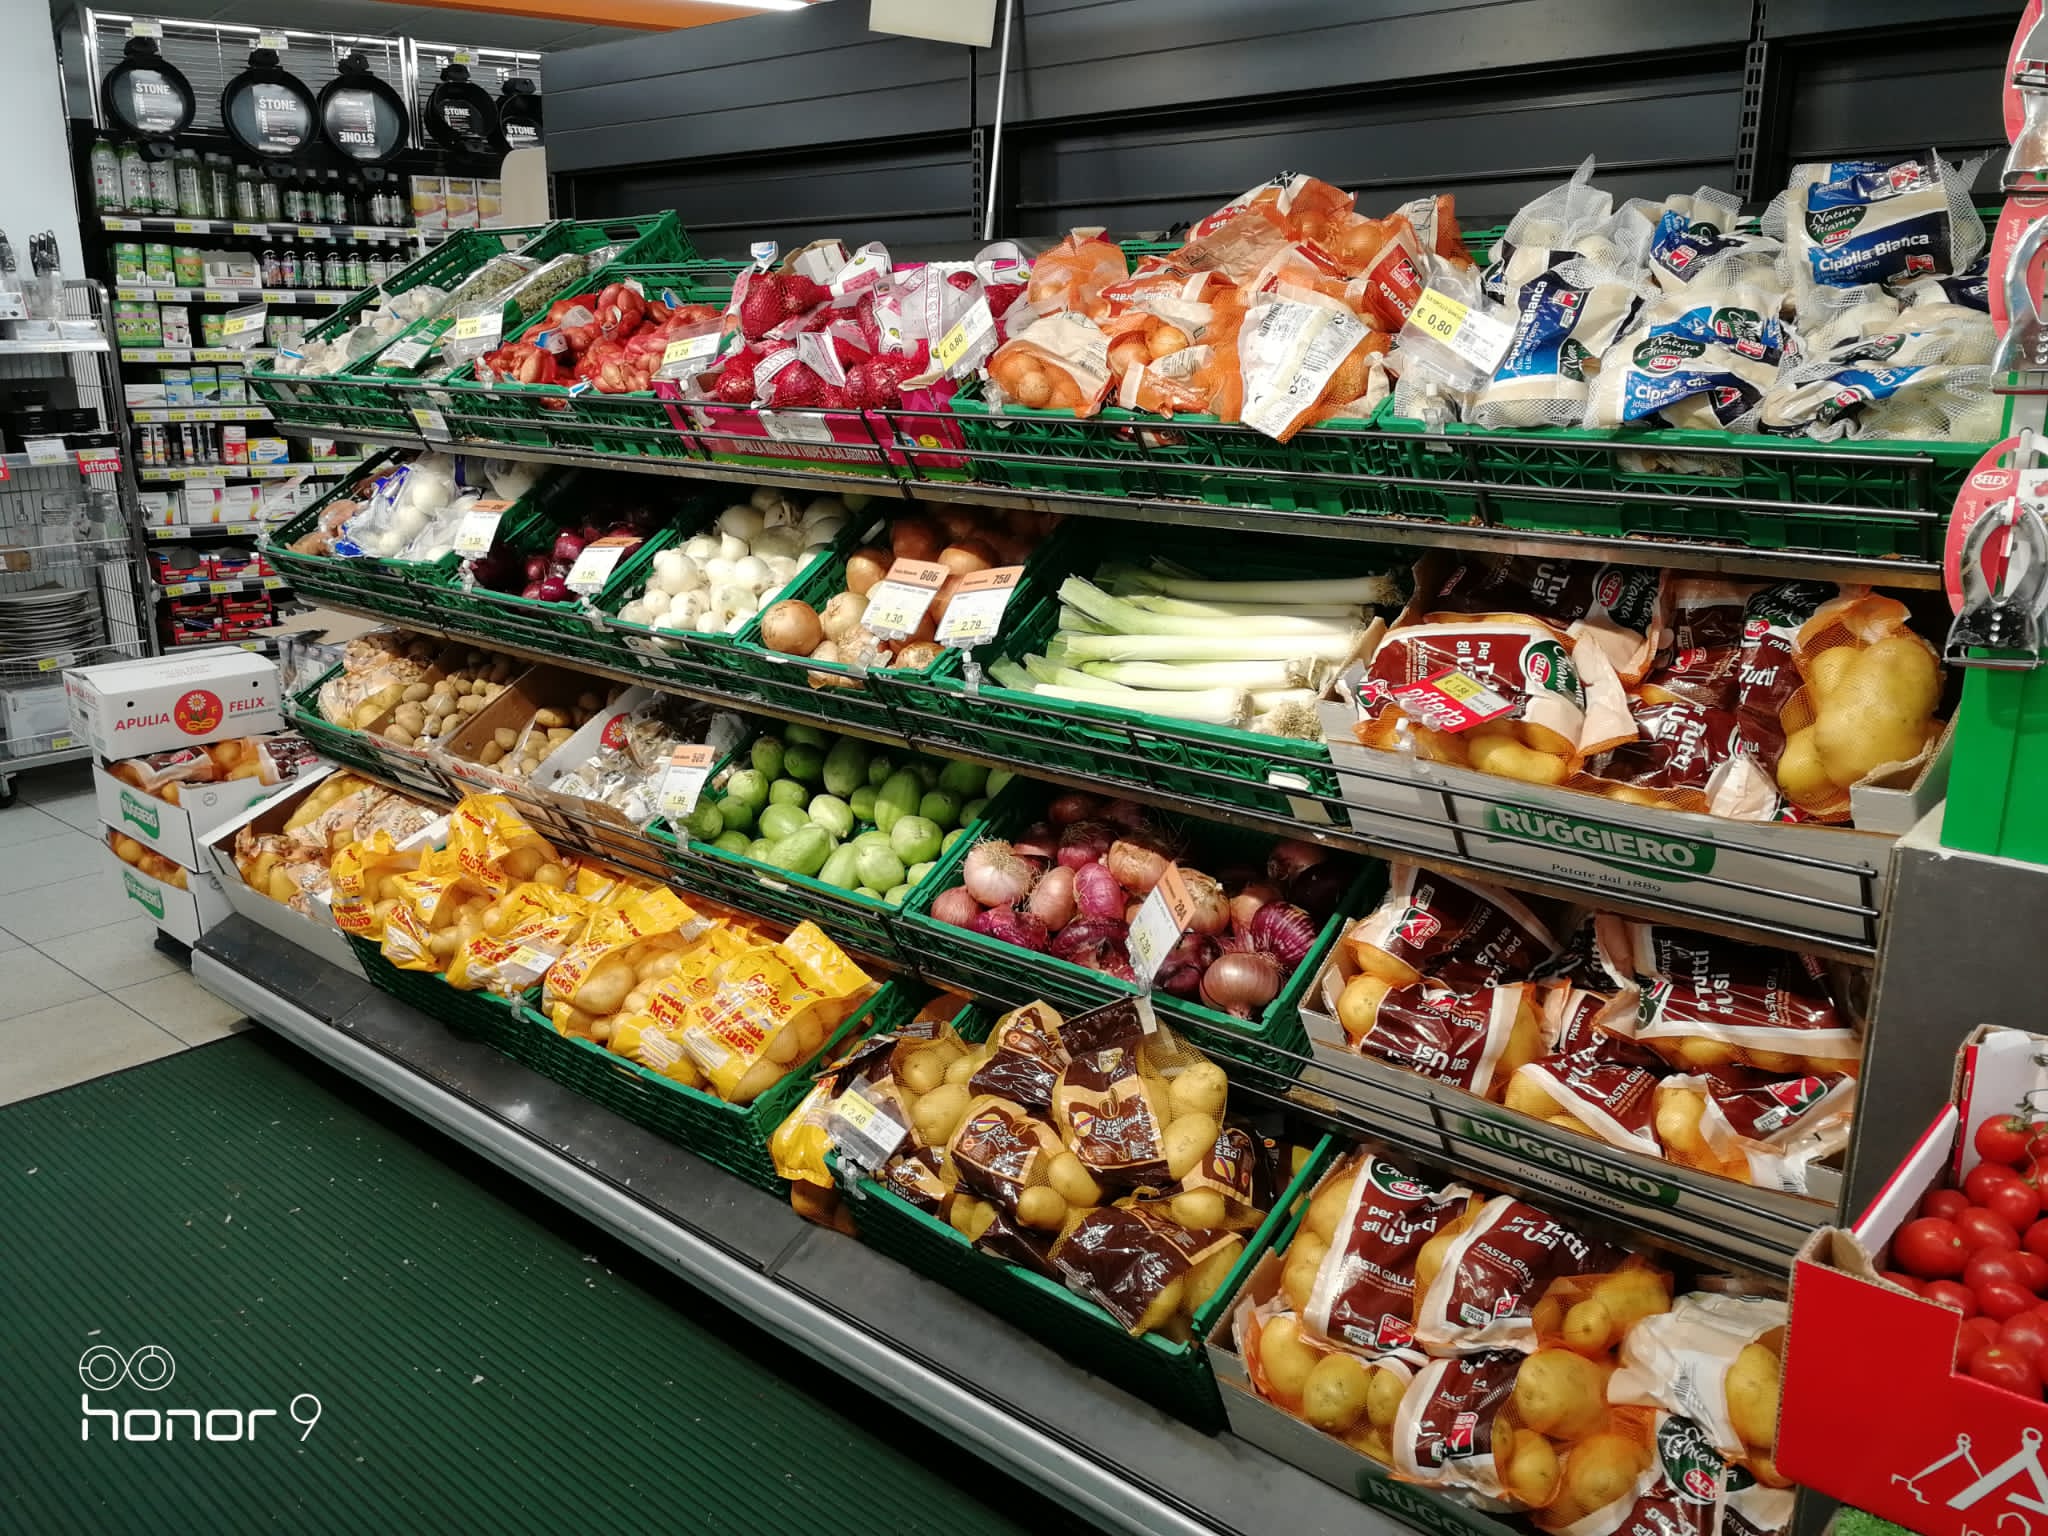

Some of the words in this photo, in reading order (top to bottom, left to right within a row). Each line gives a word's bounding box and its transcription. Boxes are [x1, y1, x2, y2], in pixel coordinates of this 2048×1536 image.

[136, 82, 171, 95] STONE
[258, 98, 297, 111] STONE
[443, 107, 471, 117] STONE
[339, 131, 376, 144] STONE
[506, 125, 537, 136] STONE
[1812, 205, 1863, 225] Natura
[1873, 234, 1930, 257] Bianca
[1379, 281, 1412, 320] Dorata
[1521, 281, 1548, 324] Bianca
[1416, 307, 1426, 319] €
[1427, 314, 1453, 336] 0,80
[948, 334, 965, 352] 0,80
[1650, 335, 1701, 352] Natura
[84, 460, 119, 473] offerta
[1974, 473, 2010, 487] SELEX
[919, 568, 940, 583] 606
[992, 573, 1011, 585] 750
[1530, 563, 1554, 599] Usi
[1600, 572, 1622, 608] SELEX
[961, 619, 982, 631] 2.79
[1456, 640, 1472, 655] gli
[1478, 641, 1492, 661] per
[1738, 663, 1780, 688] Tutti
[228, 696, 266, 713] FELIX
[1406, 687, 1468, 728] offerta
[114, 712, 171, 732] APULIA
[1661, 706, 1690, 742] Usi
[1495, 806, 1697, 868] RUGGIERO
[458, 847, 504, 884] Gustose
[1551, 862, 1597, 880] Patate
[1599, 871, 1622, 884] dal
[1694, 950, 1713, 999] Tutti
[1713, 973, 1735, 1005] Usi
[1450, 1016, 1484, 1033] PASTA
[1568, 1006, 1590, 1041] PATATE
[1603, 1081, 1631, 1109] PASTA
[841, 1103, 849, 1113] €
[1470, 1120, 1662, 1198] RUGGIERO
[1368, 1205, 1394, 1220] per
[1360, 1219, 1381, 1233] gli
[1380, 1224, 1411, 1246] Usi
[1522, 1227, 1561, 1250] Usi
[1543, 1219, 1591, 1261] Tutti
[1477, 1242, 1513, 1265] PASTA
[1382, 1269, 1418, 1288] GIALLA
